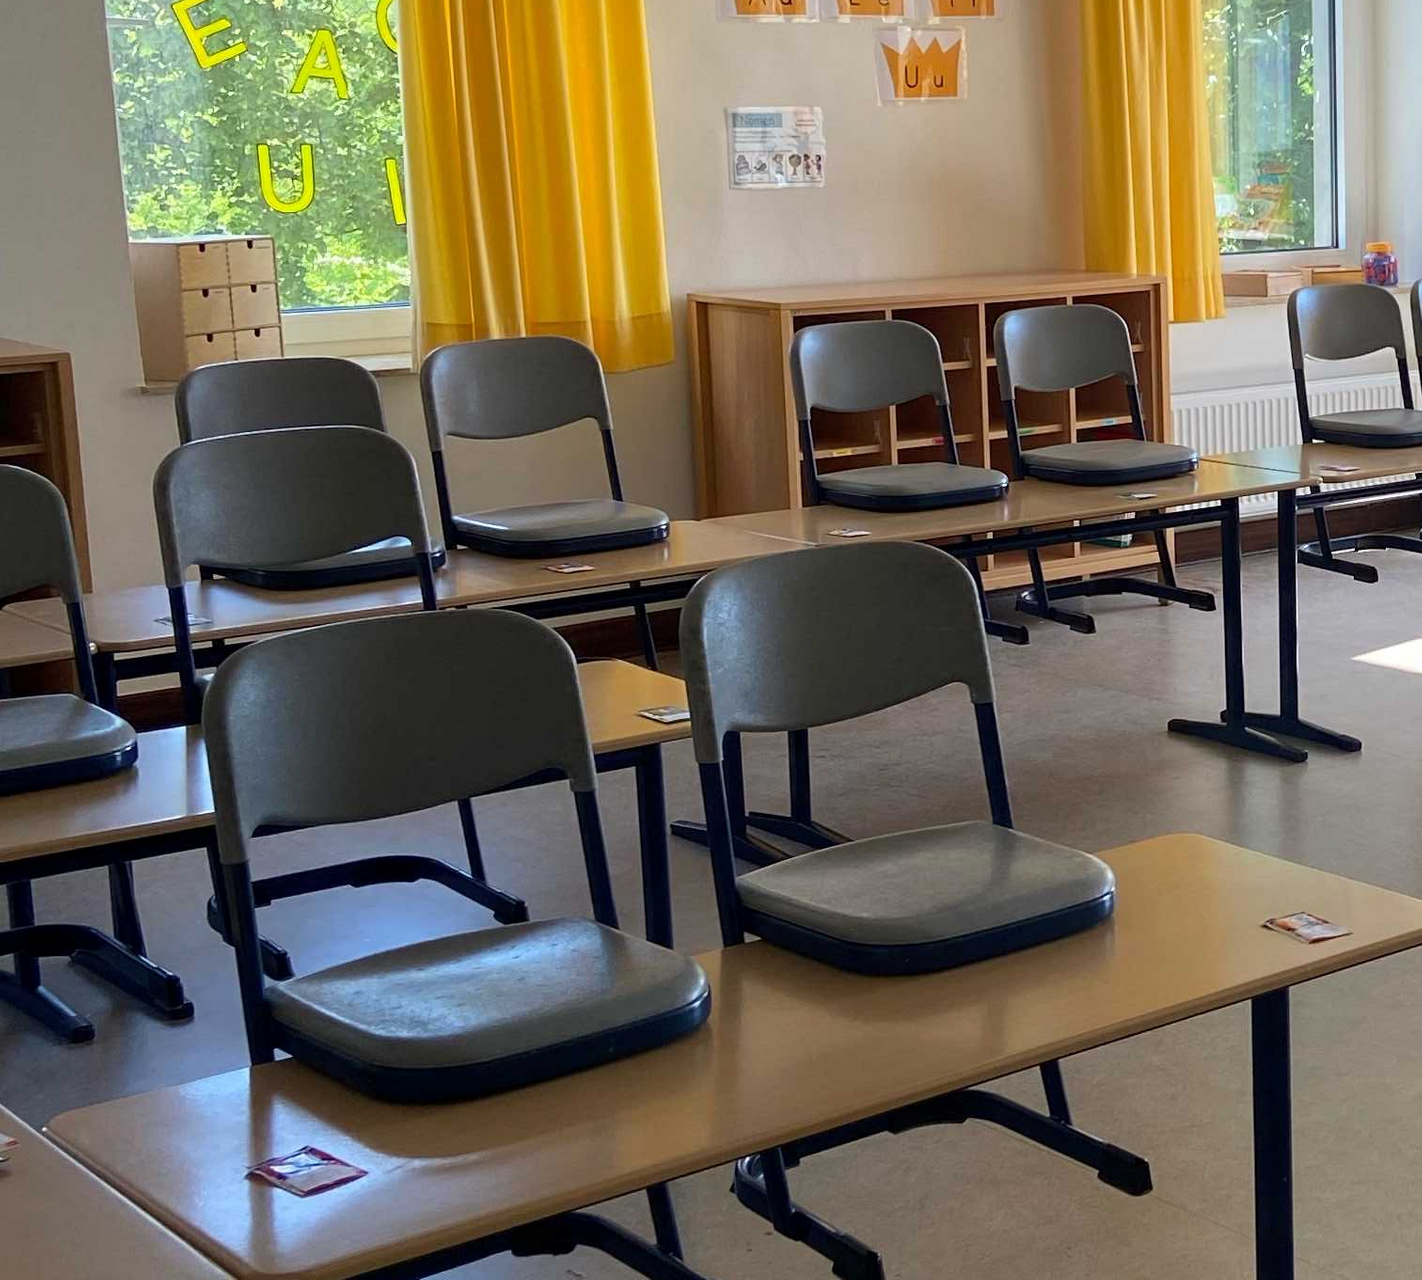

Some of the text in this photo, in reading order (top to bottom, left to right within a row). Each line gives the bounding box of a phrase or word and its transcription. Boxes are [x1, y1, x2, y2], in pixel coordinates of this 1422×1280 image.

[171, 0, 248, 68] E
[290, 28, 350, 100] A
[904, 64, 944, 88] U u
[256, 143, 315, 213] U
